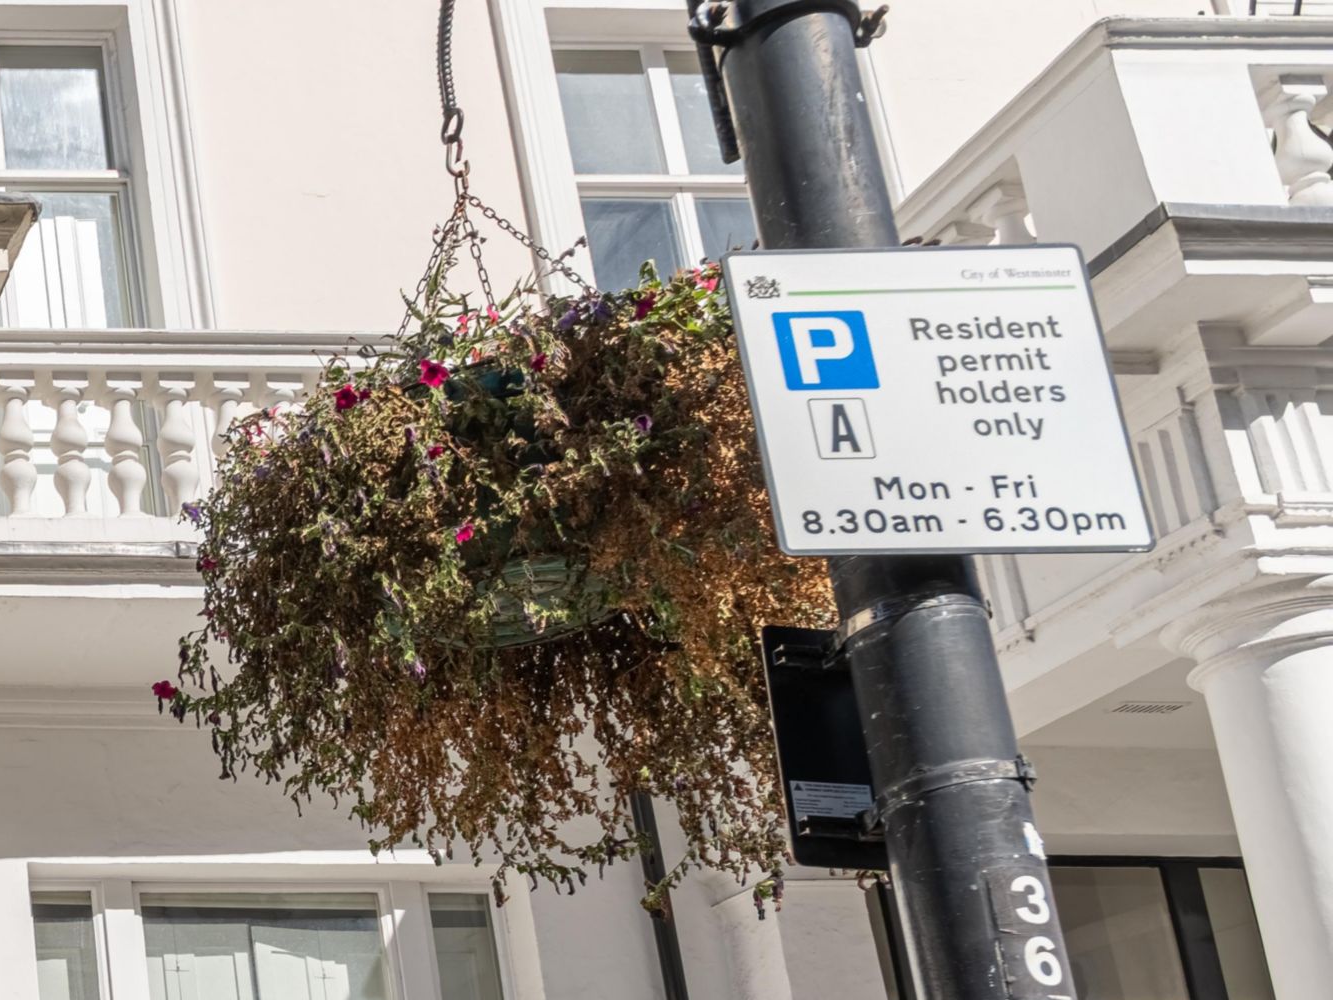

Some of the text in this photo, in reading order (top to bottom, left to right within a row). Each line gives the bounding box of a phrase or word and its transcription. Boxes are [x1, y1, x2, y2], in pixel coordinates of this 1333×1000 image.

[960, 266, 1071, 281] City of Westminster
[909, 315, 1062, 341] Resident
[789, 317, 854, 384] P
[936, 347, 1051, 377] permit
[935, 379, 1066, 405] holders
[831, 403, 862, 453] A
[973, 412, 1044, 441] only
[873, 476, 951, 501] Mon
[990, 474, 1038, 499] Fri
[801, 508, 944, 535] 8.30am
[983, 506, 1127, 536] 6.30pm
